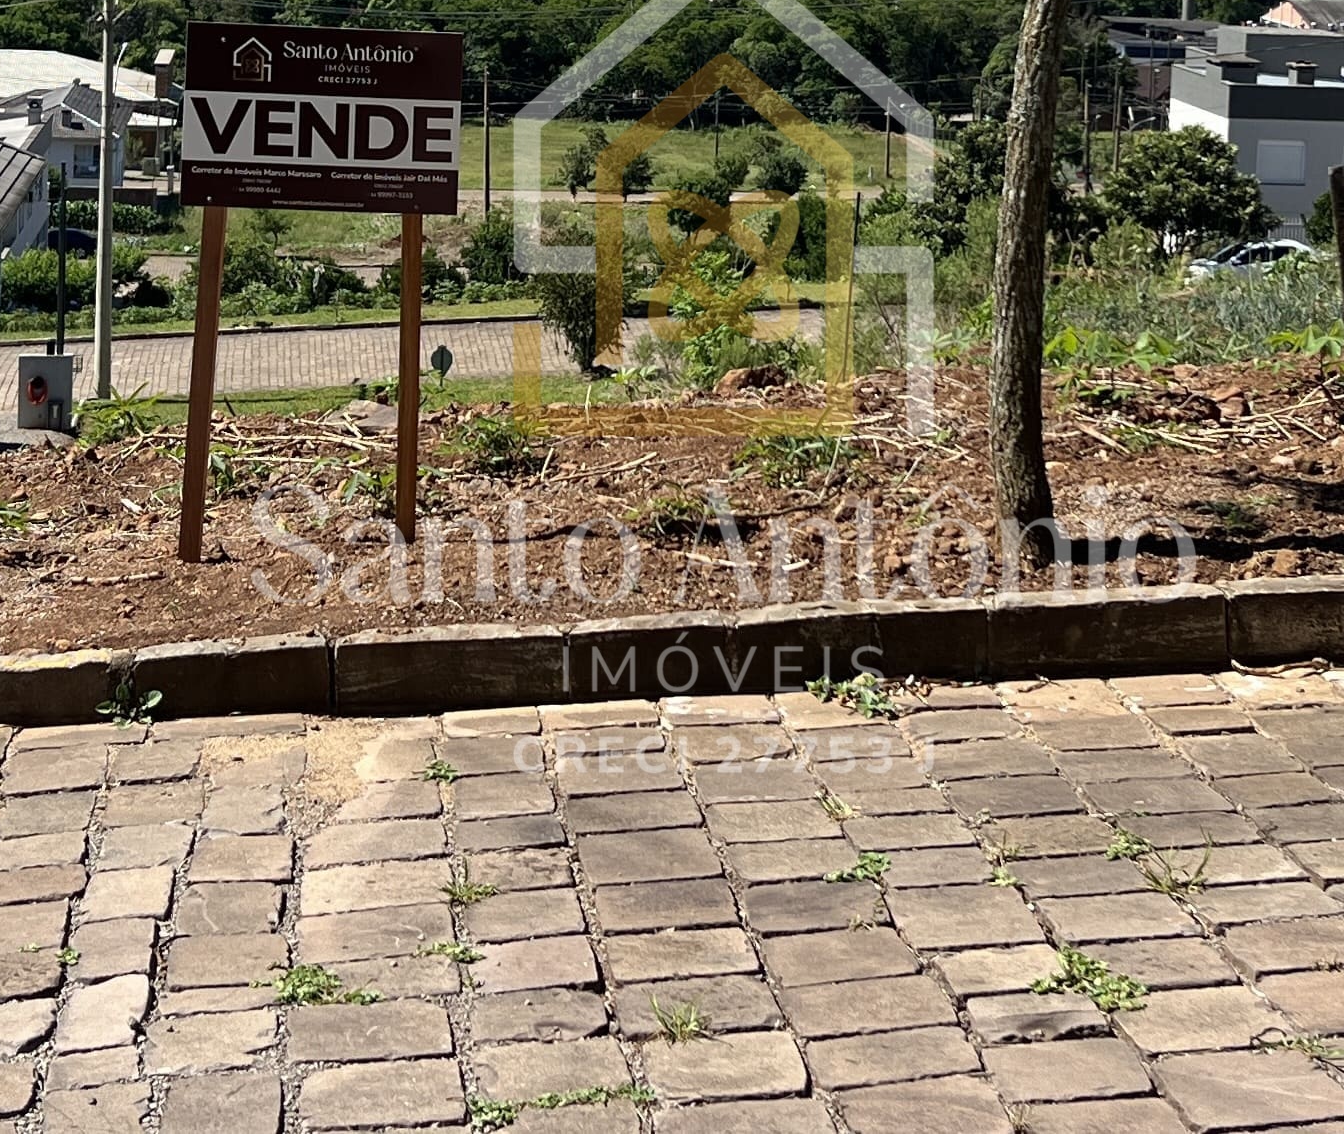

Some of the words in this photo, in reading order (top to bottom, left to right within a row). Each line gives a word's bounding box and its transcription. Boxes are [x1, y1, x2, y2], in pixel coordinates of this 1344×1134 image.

[283, 40, 338, 60] Santo
[341, 43, 414, 63] Antônio
[324, 63, 371, 74] IMÓVEIS
[318, 75, 344, 84] CRECI
[190, 96, 454, 163] VENDE
[191, 166, 222, 174] Corretor
[330, 171, 362, 180] Corretor
